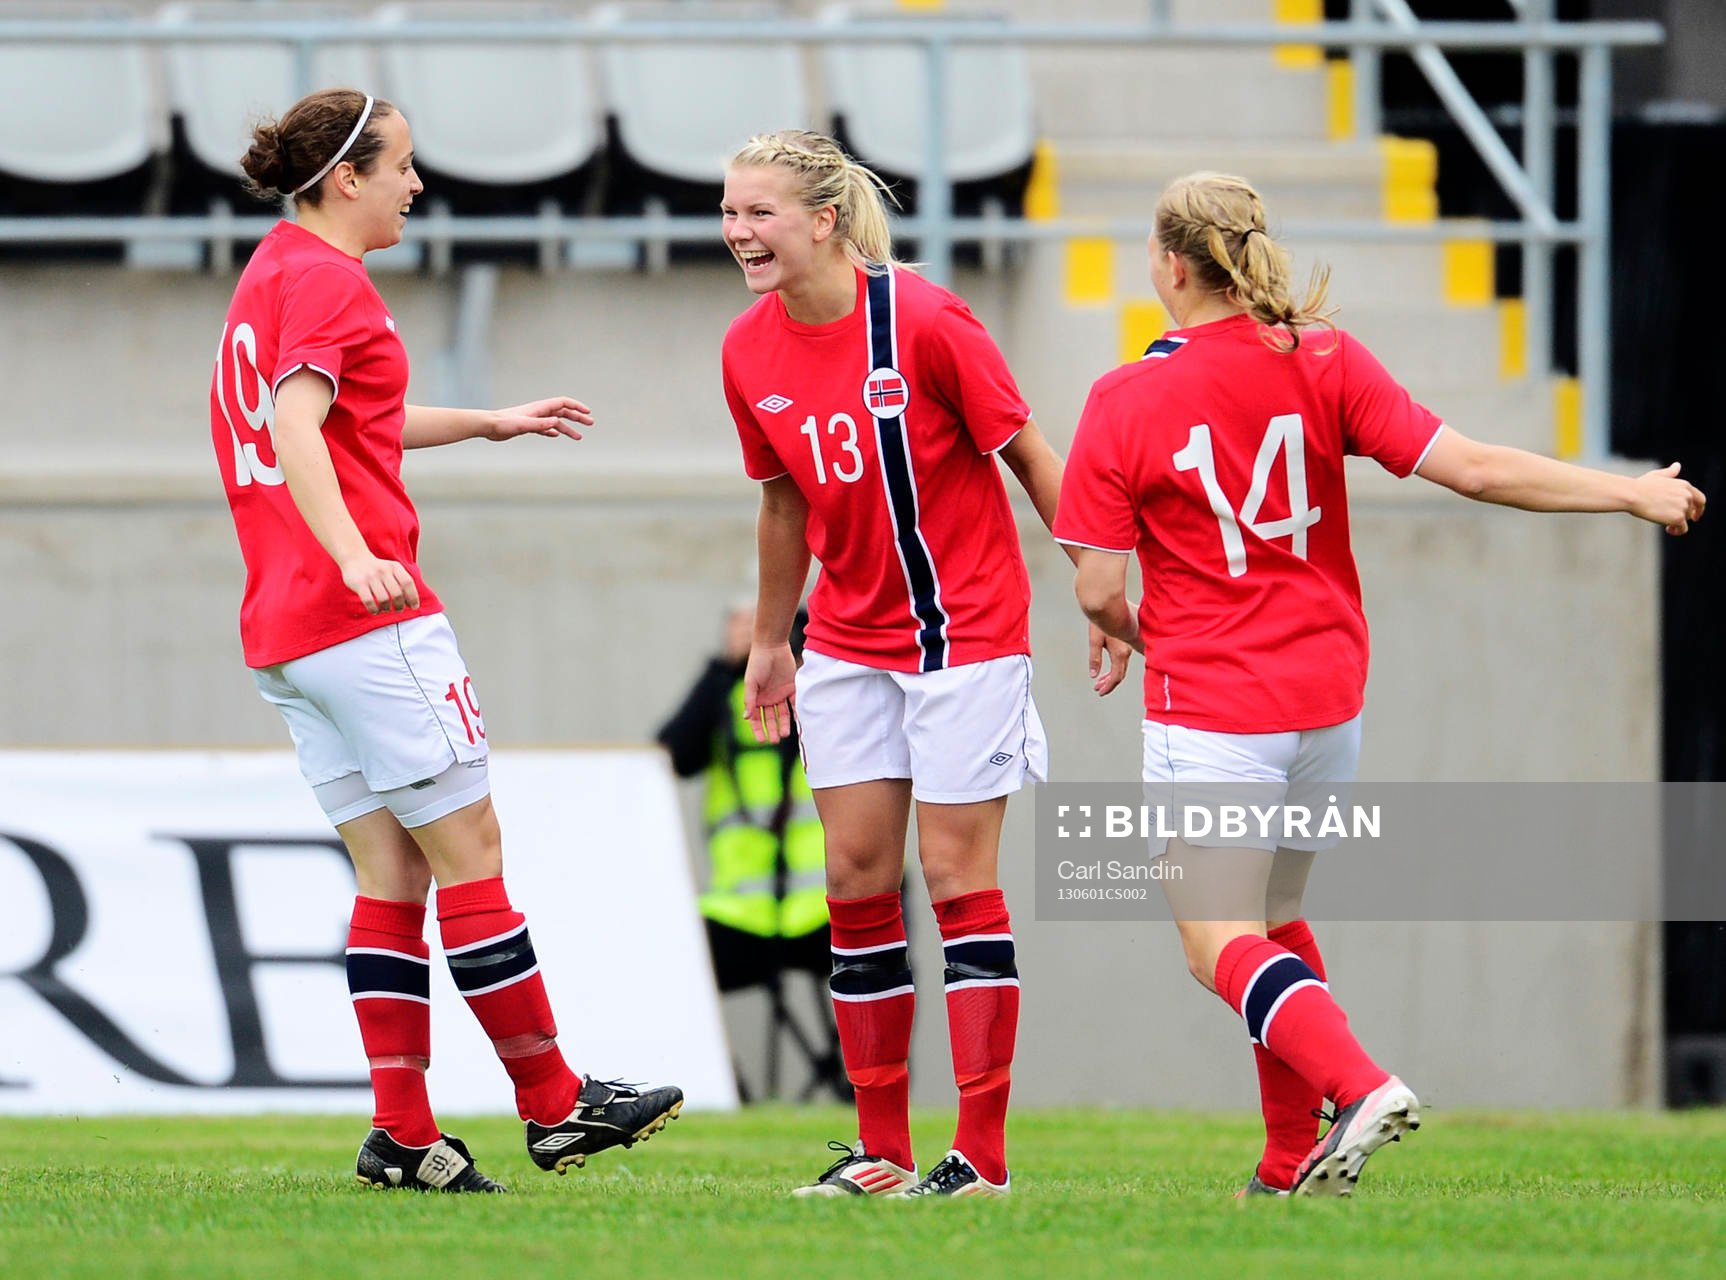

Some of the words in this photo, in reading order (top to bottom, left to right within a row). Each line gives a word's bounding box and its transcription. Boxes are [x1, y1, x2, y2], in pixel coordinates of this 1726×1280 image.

[216, 322, 286, 487] 19
[800, 412, 864, 484] 13
[1172, 413, 1322, 578] 14
